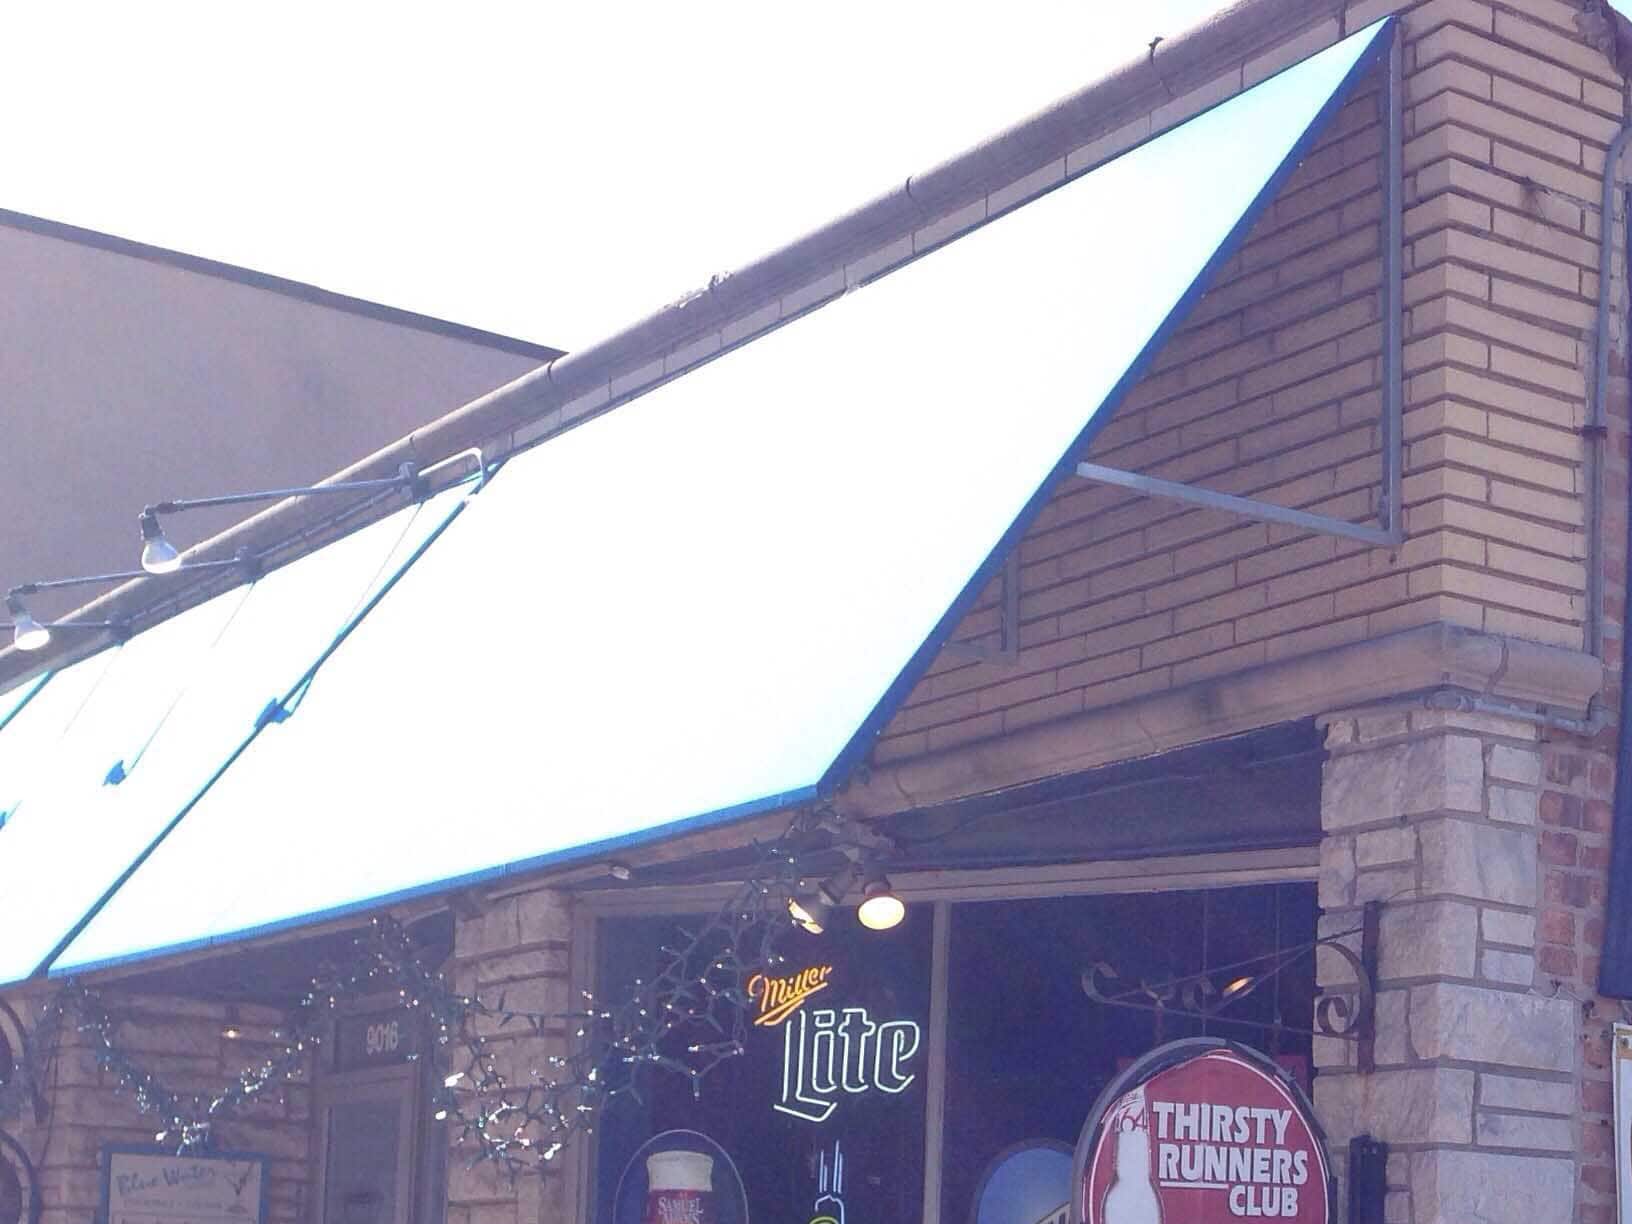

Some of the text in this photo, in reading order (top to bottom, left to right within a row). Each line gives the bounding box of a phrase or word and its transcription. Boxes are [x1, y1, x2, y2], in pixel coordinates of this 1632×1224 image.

[748, 966, 832, 1020] Miller
[774, 1008, 920, 1122] Lite
[1153, 1102, 1292, 1144] THIRSTY
[1158, 1144, 1307, 1185] RUNNERS
[1229, 1184, 1298, 1217] CLUB
